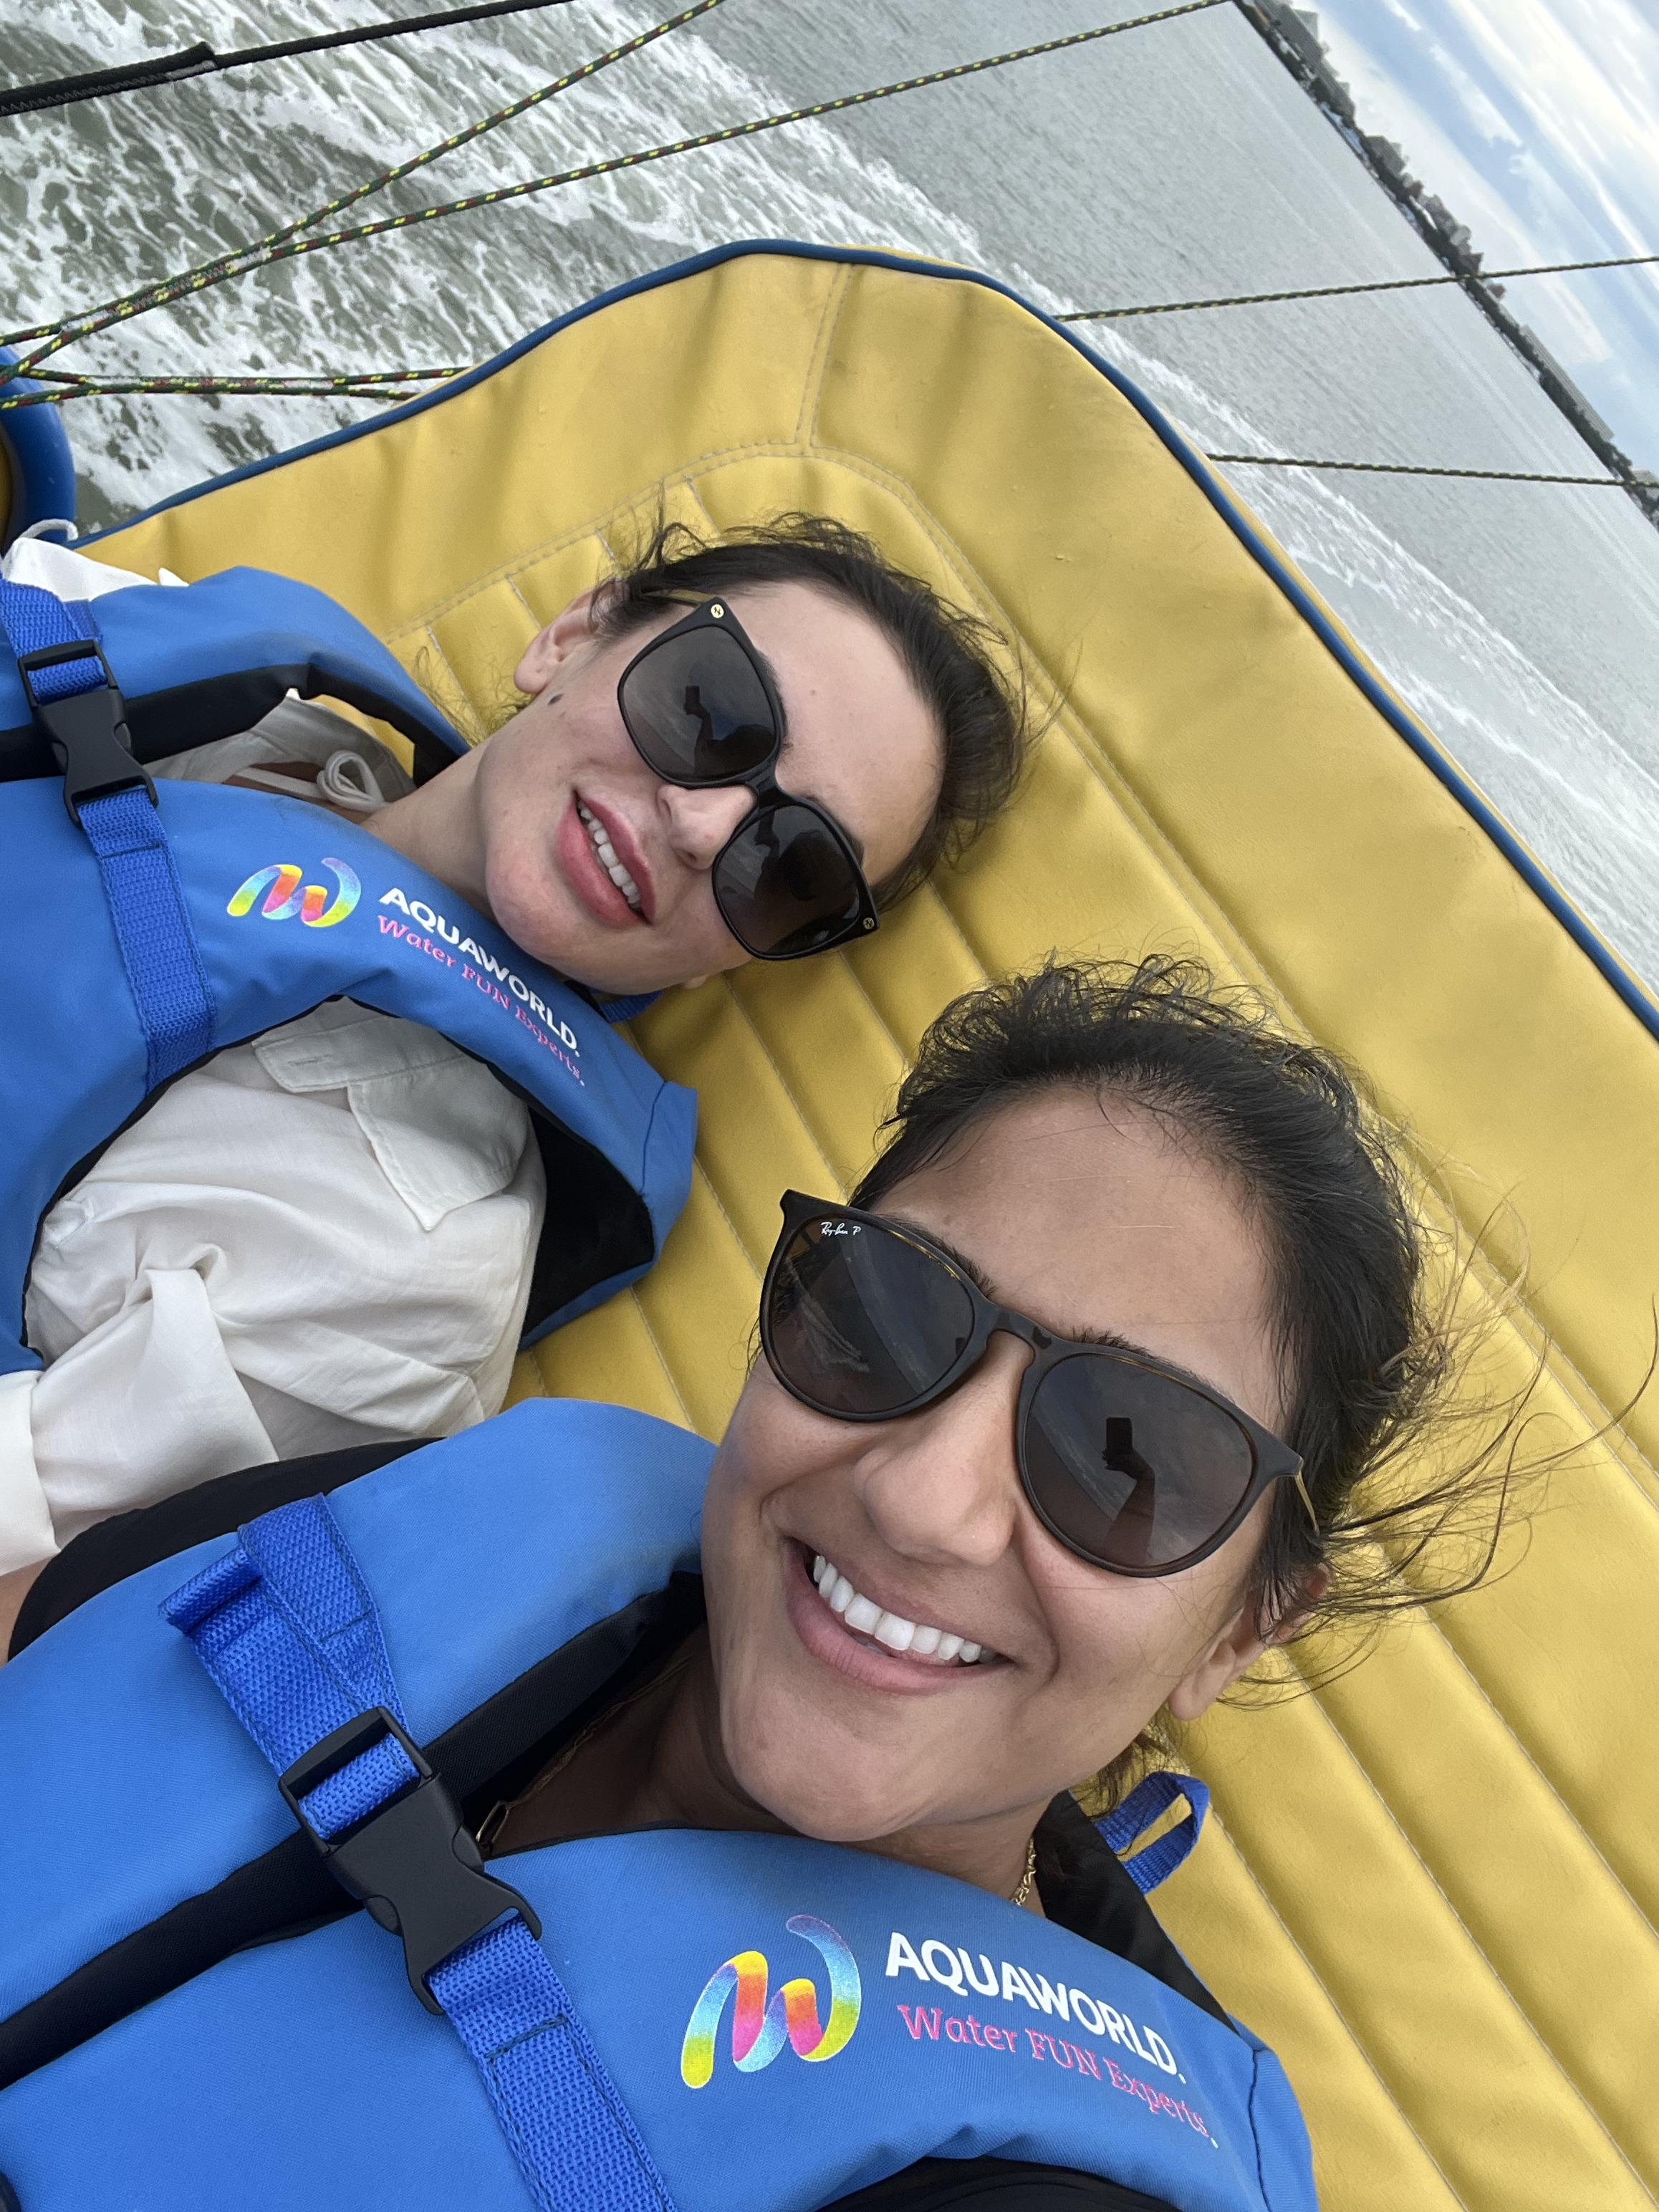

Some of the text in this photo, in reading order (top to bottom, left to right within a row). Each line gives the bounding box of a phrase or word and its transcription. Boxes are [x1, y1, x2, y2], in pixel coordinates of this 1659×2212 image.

[378, 915, 457, 967] Water
[463, 963, 511, 1010] FUN
[886, 1933, 1186, 2084] AQUAWORLD.
[898, 2005, 1017, 2053] Water
[1025, 2029, 1102, 2081] FUN
